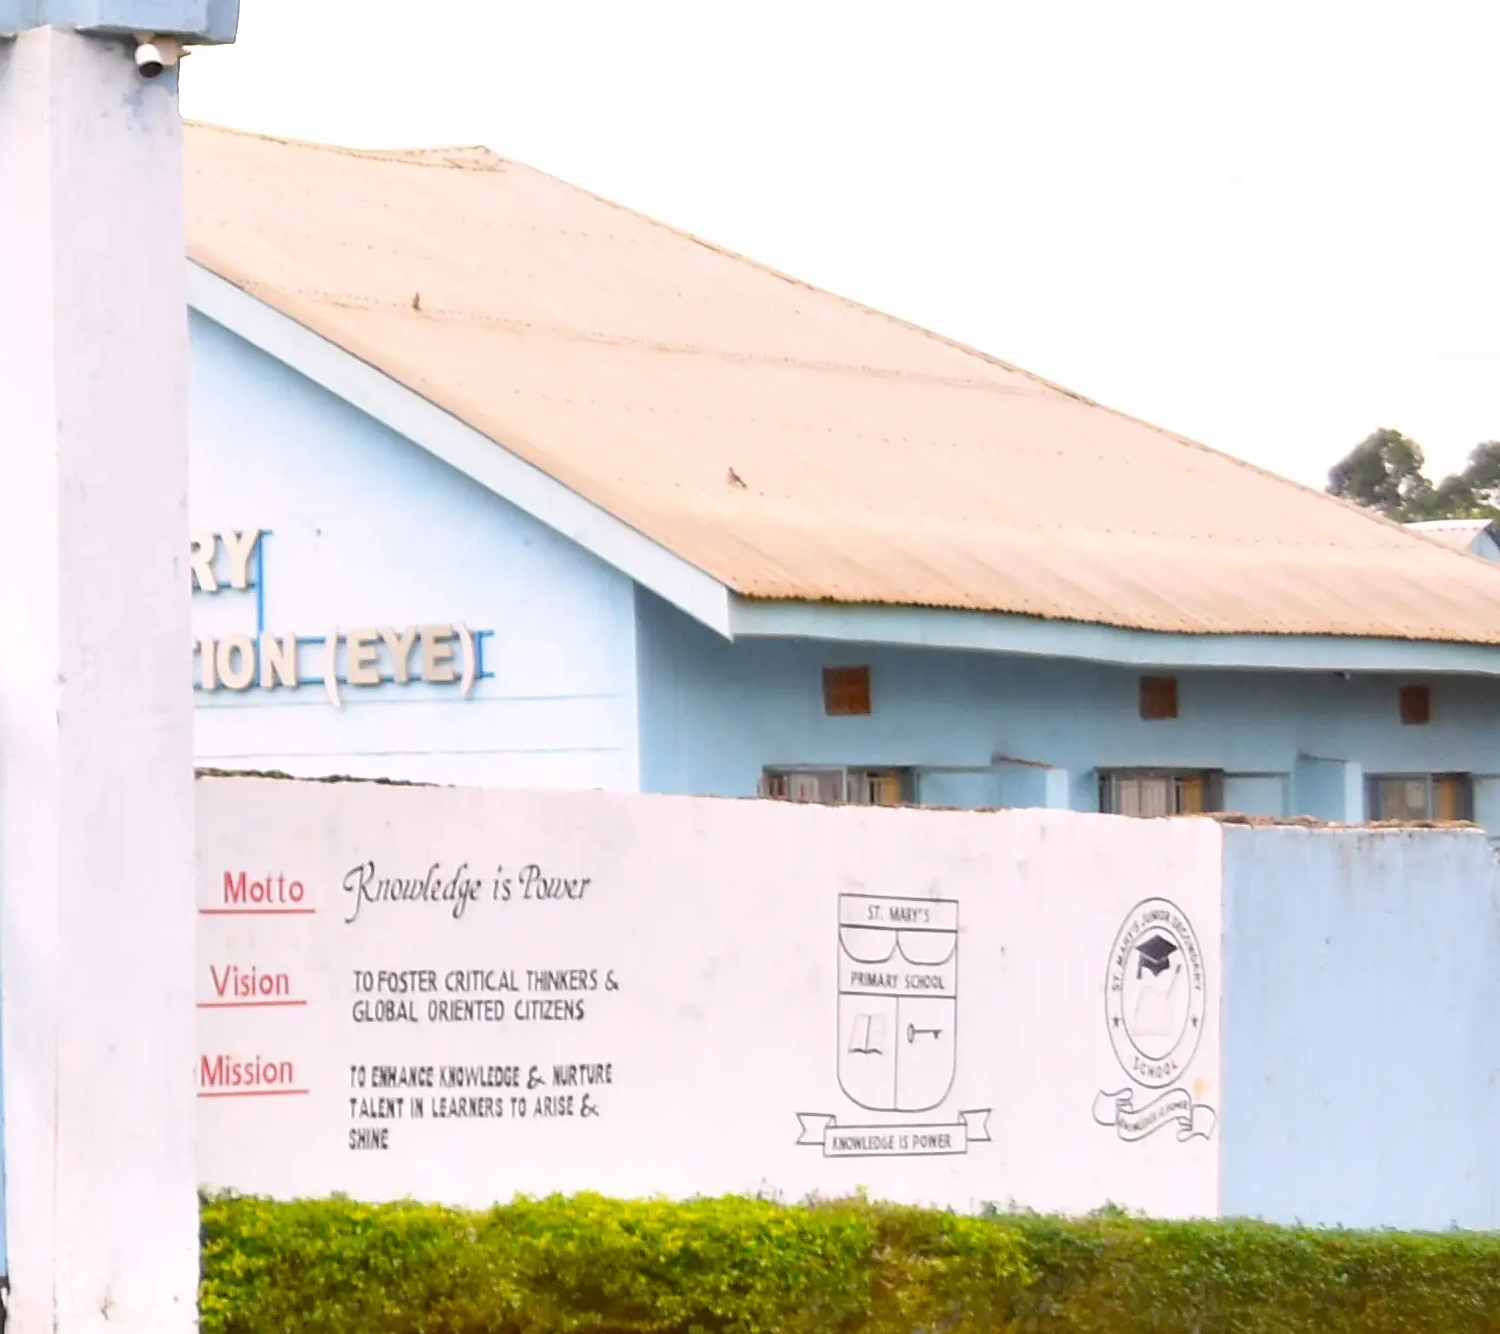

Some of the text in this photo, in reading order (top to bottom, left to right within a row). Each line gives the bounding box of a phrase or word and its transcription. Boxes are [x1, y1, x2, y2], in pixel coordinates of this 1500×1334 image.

[324, 621, 475, 707] (EYE)
[224, 871, 304, 904] Motto
[343, 860, 590, 924] Knowledge is Power
[210, 965, 289, 997] Vision
[354, 969, 619, 993] TO FOSTER CRITICAL THINKERS &
[851, 971, 946, 990] PRIMARY SCHOOL
[353, 999, 584, 1022] GLOBAL ORIENTED CITIZENS
[201, 1055, 292, 1087] Mission
[351, 1063, 612, 1089] TO ENHANCE KNOWLEDGE & NURTURE
[349, 1093, 599, 1118] TALENT IN LEARNERS TO ARISE &
[349, 1128, 388, 1150] SHINE
